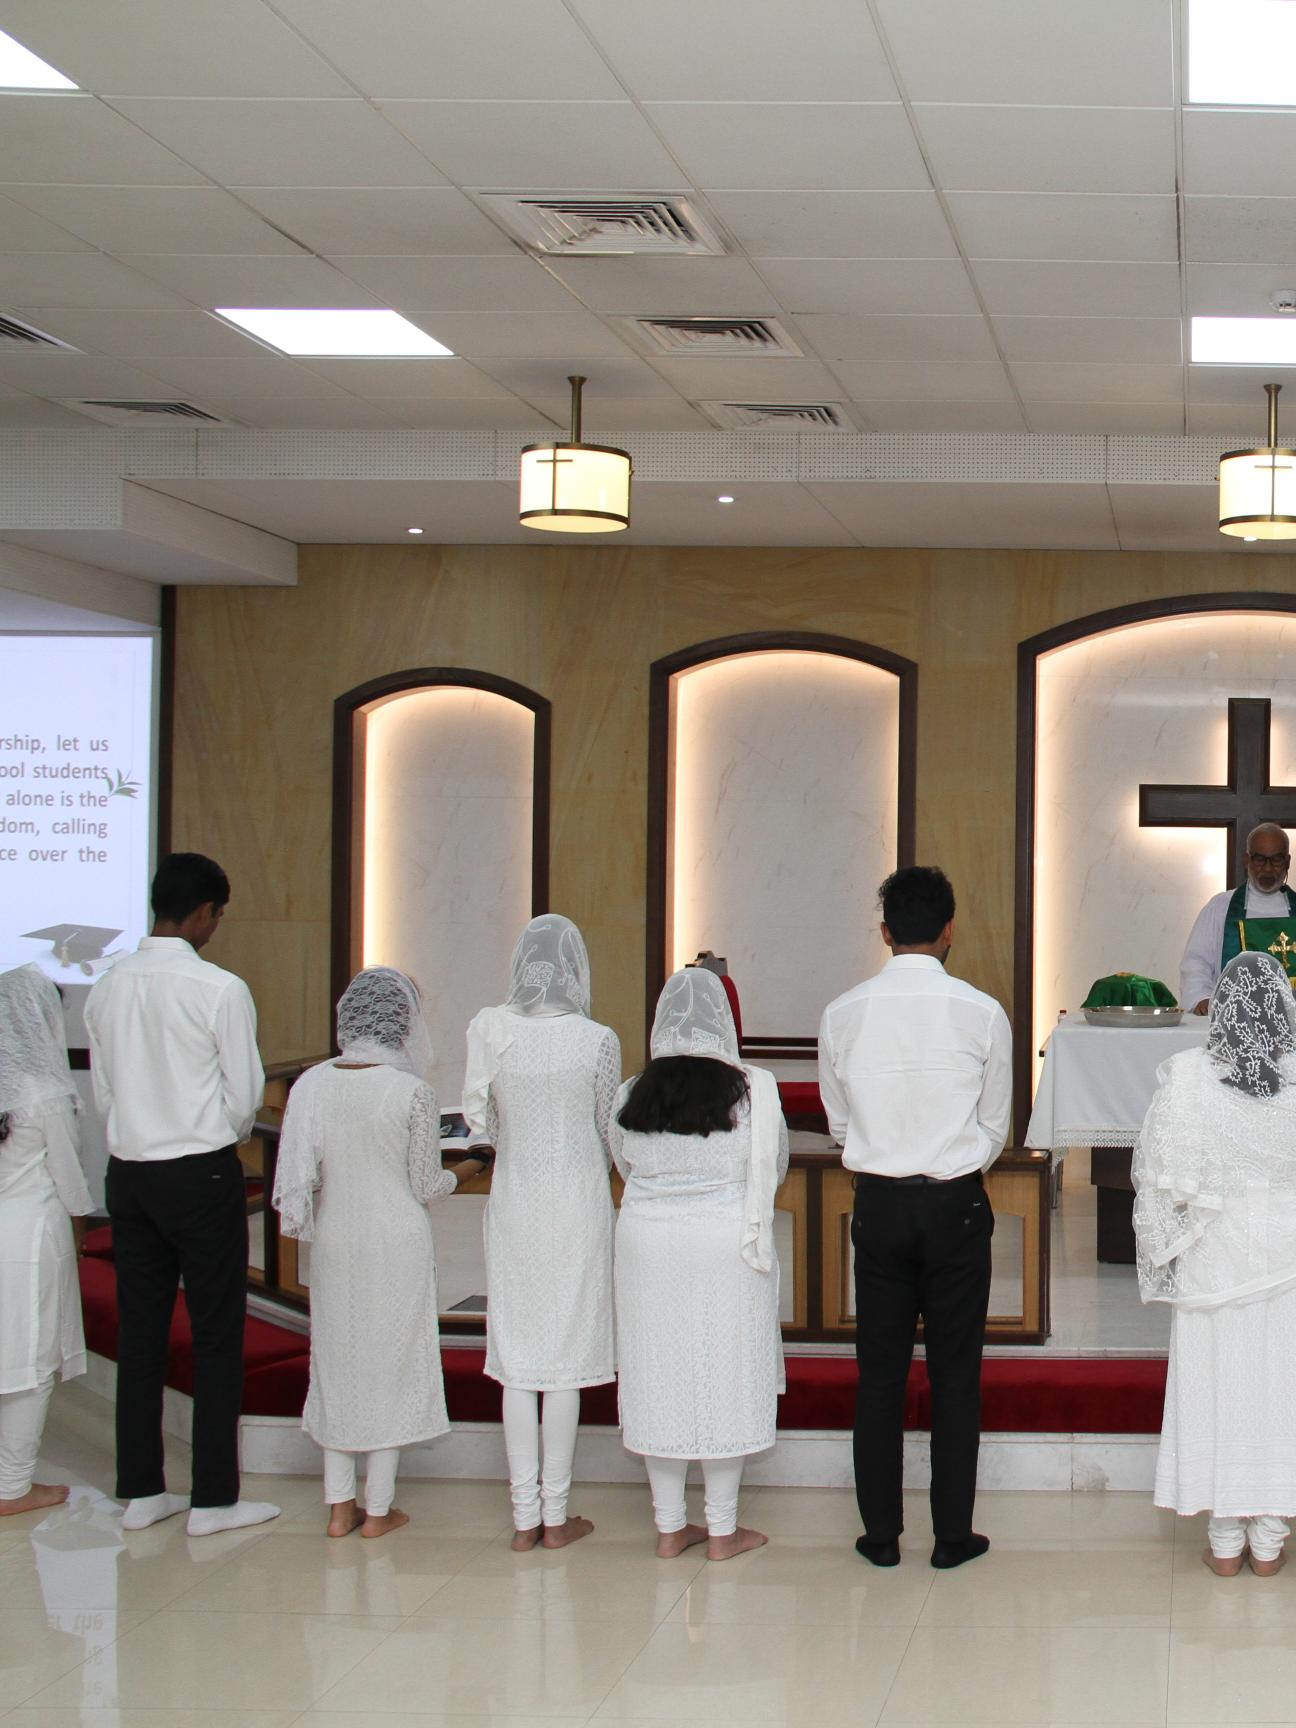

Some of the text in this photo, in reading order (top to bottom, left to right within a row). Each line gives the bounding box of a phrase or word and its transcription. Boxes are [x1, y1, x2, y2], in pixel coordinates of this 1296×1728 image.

[57, 734, 79, 751] let
[90, 739, 109, 752] us
[33, 762, 109, 779] students
[6, 789, 108, 807] alone is the
[52, 818, 108, 838] calling
[28, 850, 67, 861] over
[79, 846, 107, 862] the
